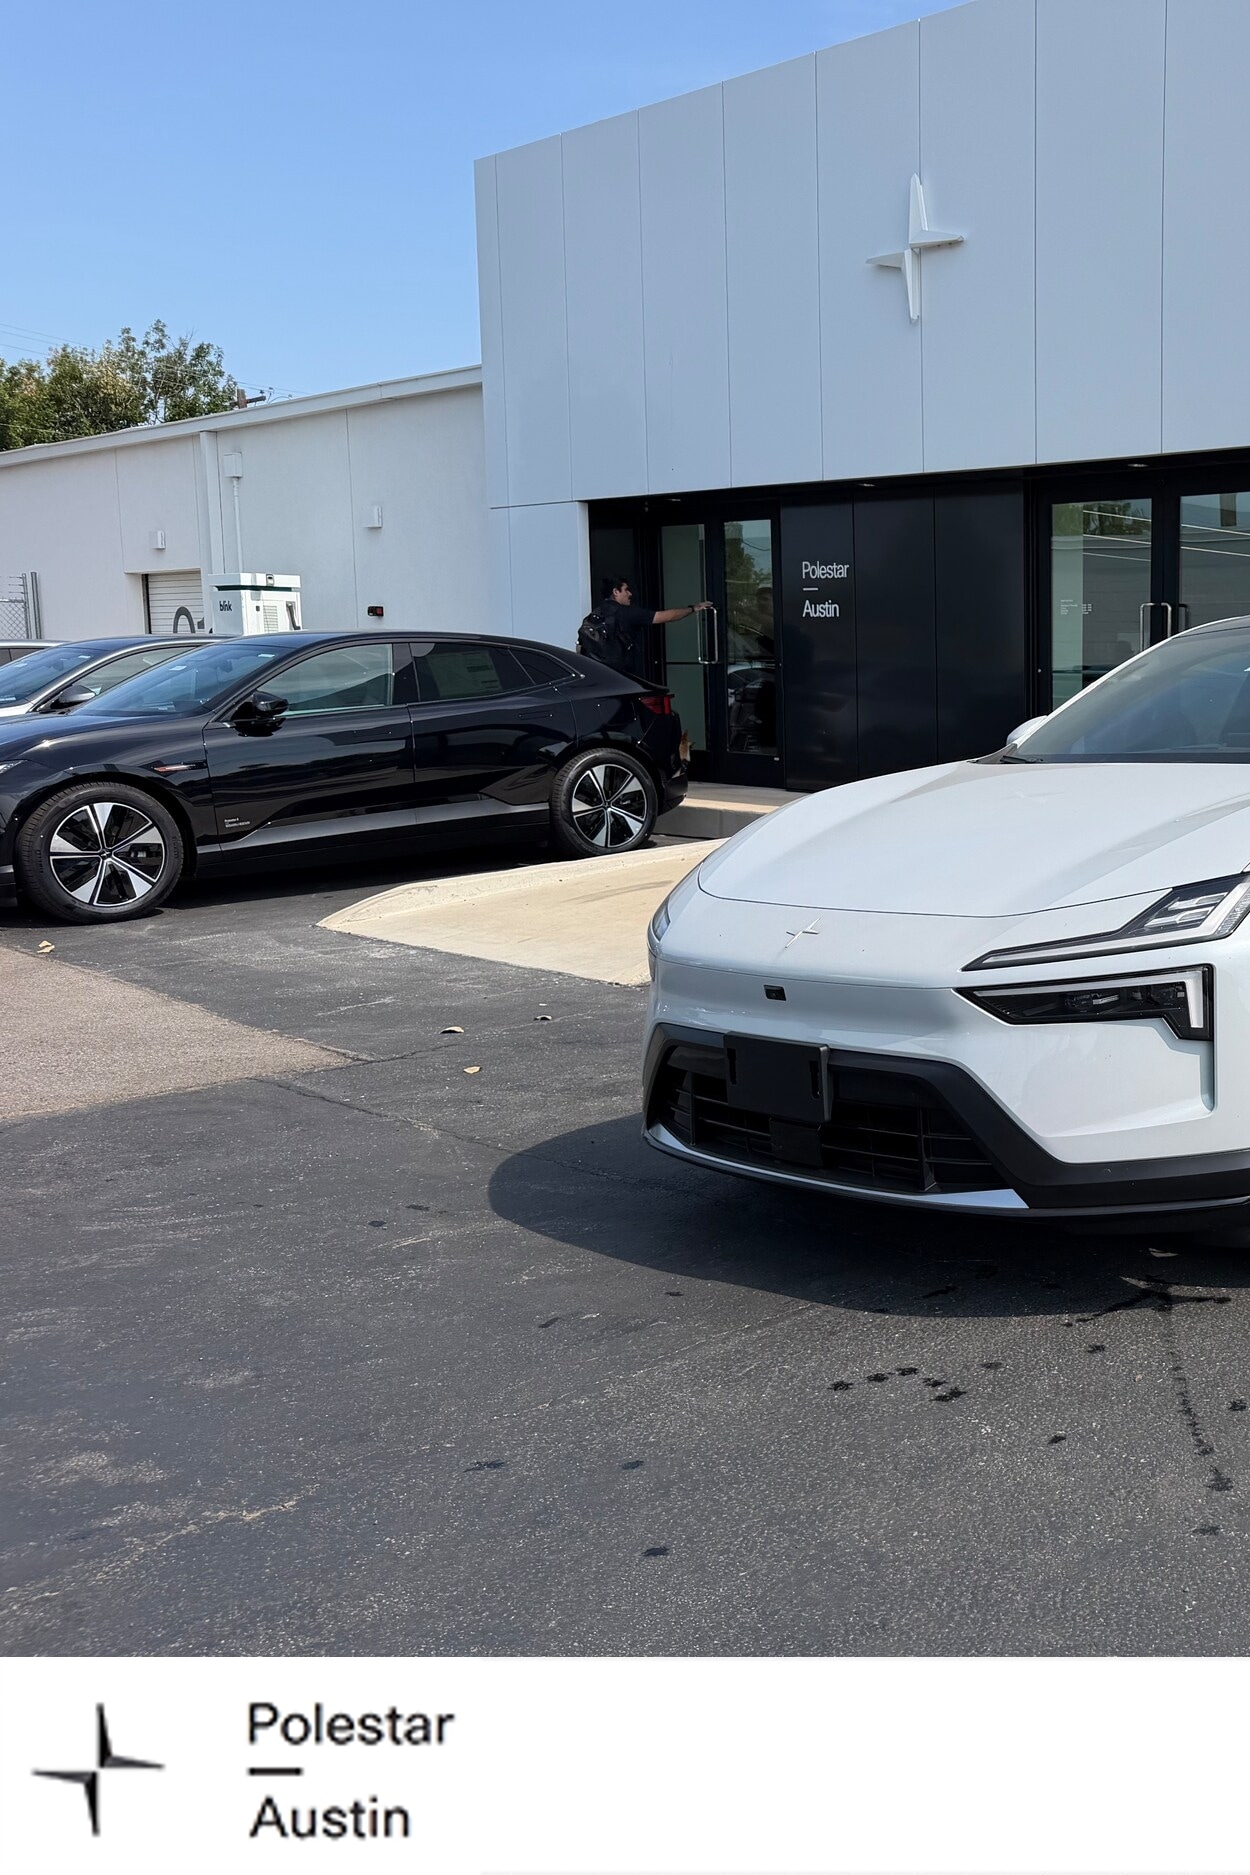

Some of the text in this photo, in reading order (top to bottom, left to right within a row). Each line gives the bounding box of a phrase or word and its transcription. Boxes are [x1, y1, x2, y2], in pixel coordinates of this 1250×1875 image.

[802, 560, 850, 579] Polestar
[219, 600, 233, 612] blink
[802, 599, 839, 617] Austin
